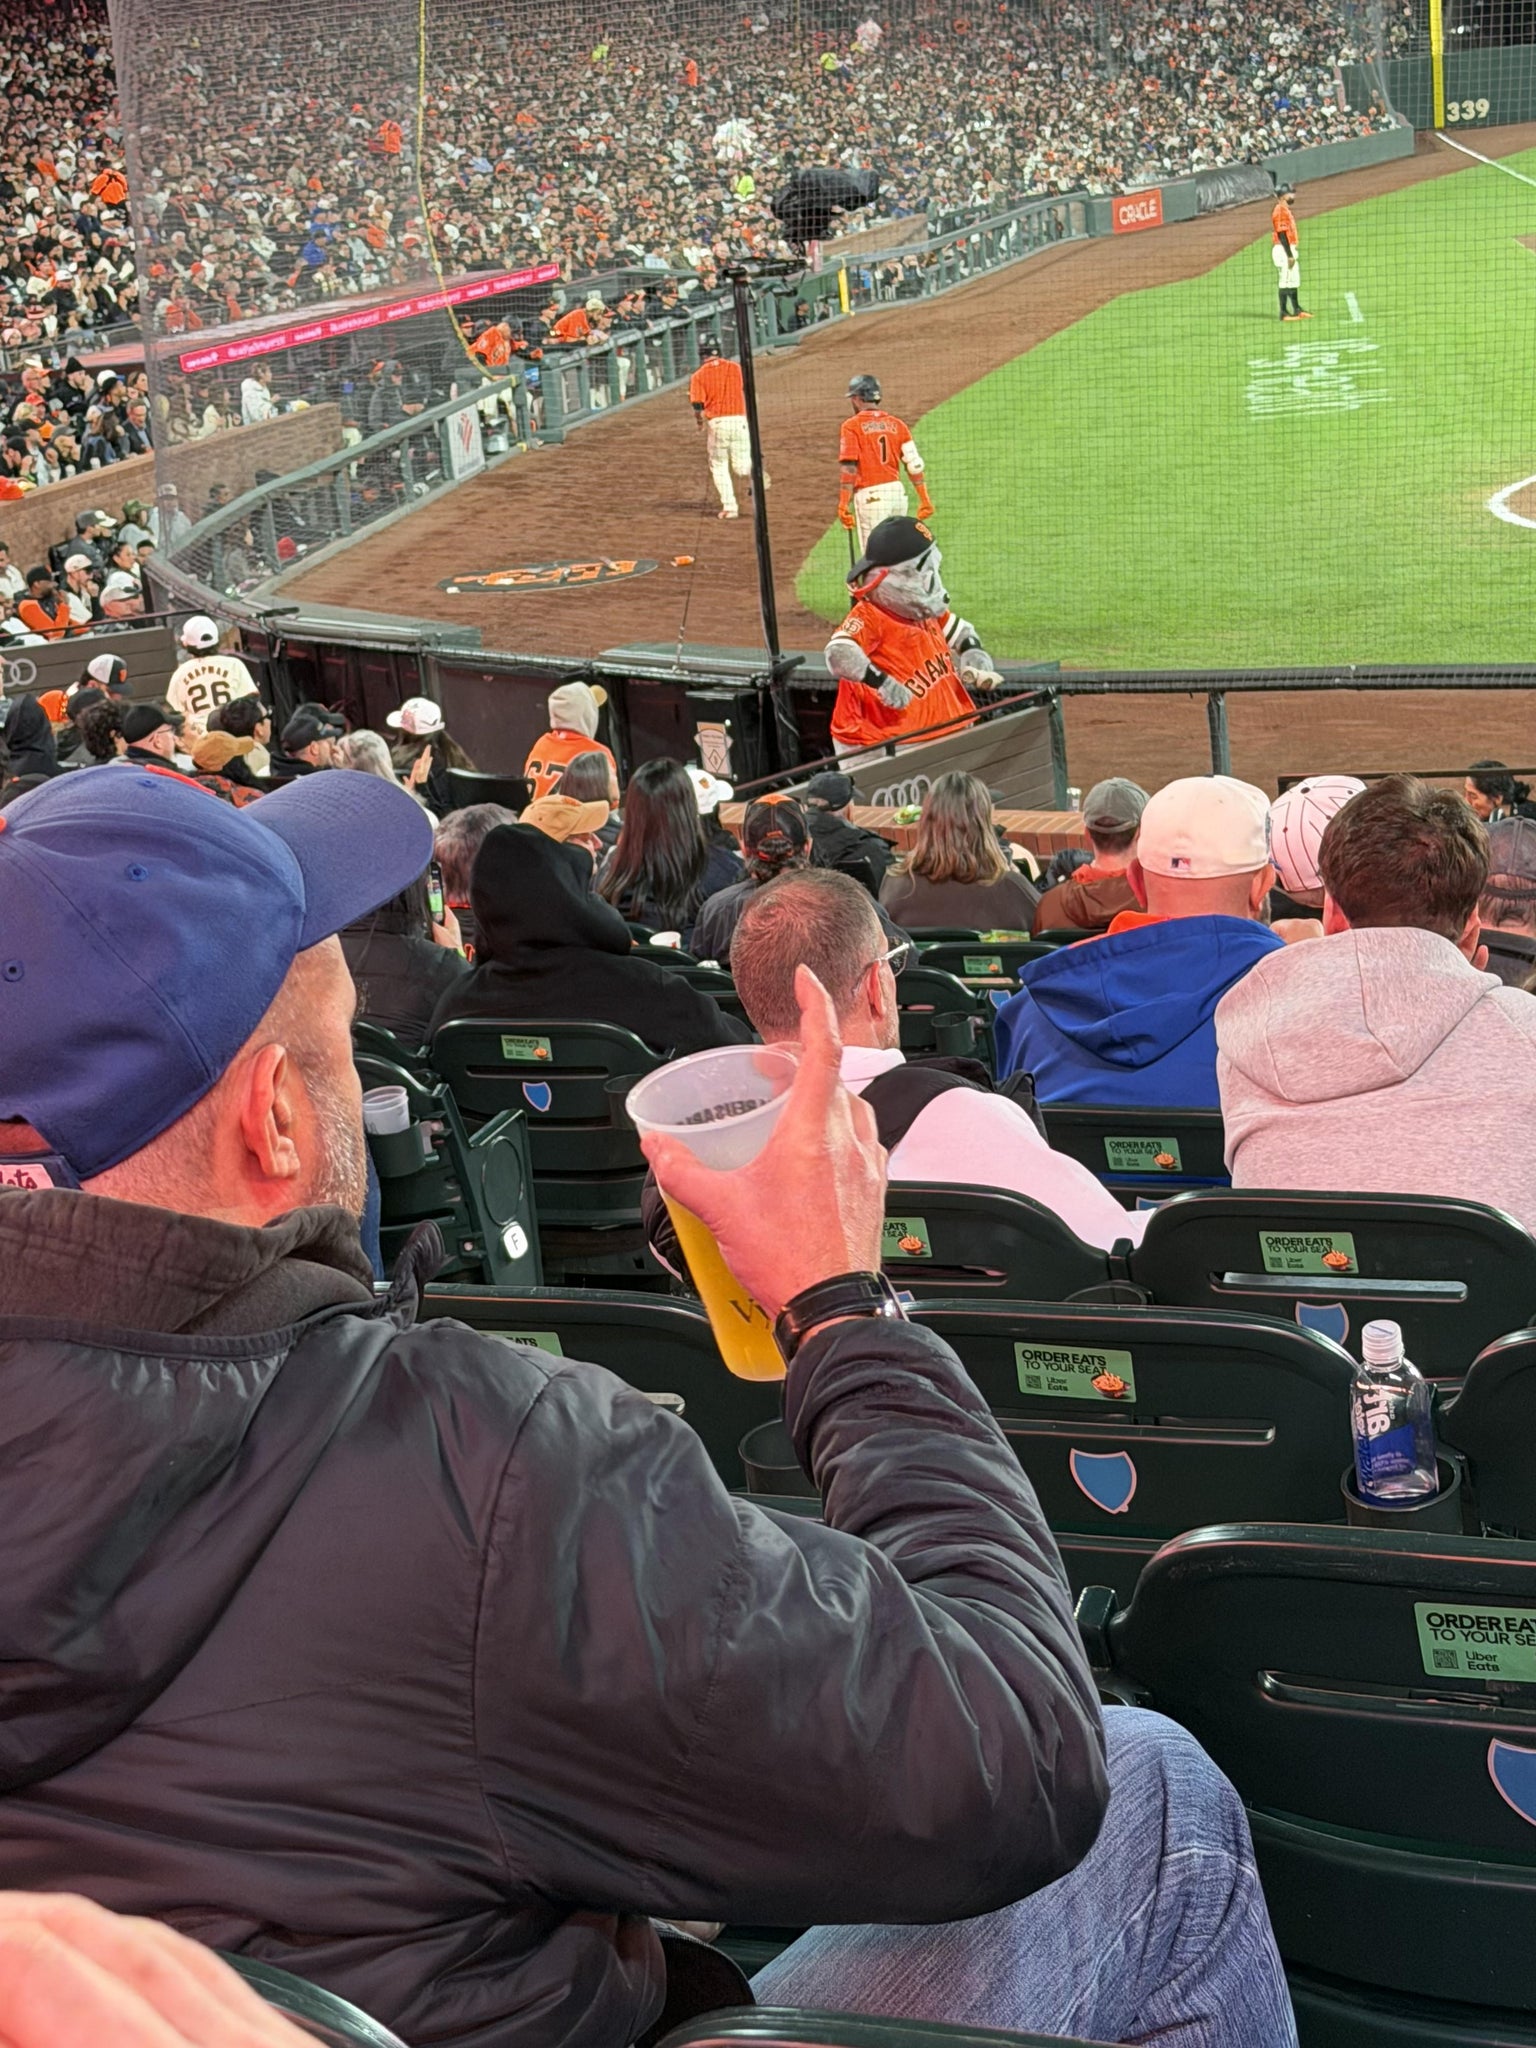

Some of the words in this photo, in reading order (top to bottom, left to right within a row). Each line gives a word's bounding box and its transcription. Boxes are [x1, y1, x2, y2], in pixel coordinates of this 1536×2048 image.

[1446, 97, 1490, 122] 339
[1118, 199, 1157, 225] ORACLE
[877, 434, 889, 464] 1
[183, 665, 229, 685] CHAPMAN
[187, 680, 231, 714] 26
[511, 1233, 519, 1251] F
[1265, 1236, 1304, 1246] ORDER
[1305, 1237, 1333, 1247] EATS
[1268, 1245, 1281, 1253] TO
[1283, 1245, 1309, 1253] YOUR
[1022, 1349, 1070, 1364] ORDER
[1072, 1353, 1106, 1367] EATS
[1024, 1360, 1041, 1370] TO
[1043, 1361, 1076, 1373] YOUR
[1426, 1612, 1503, 1632] ORDER
[1429, 1628, 1456, 1641] TO
[1460, 1630, 1511, 1646] YOUR
[1465, 1650, 1498, 1662] Uber
[1467, 1661, 1500, 1673] Eats
